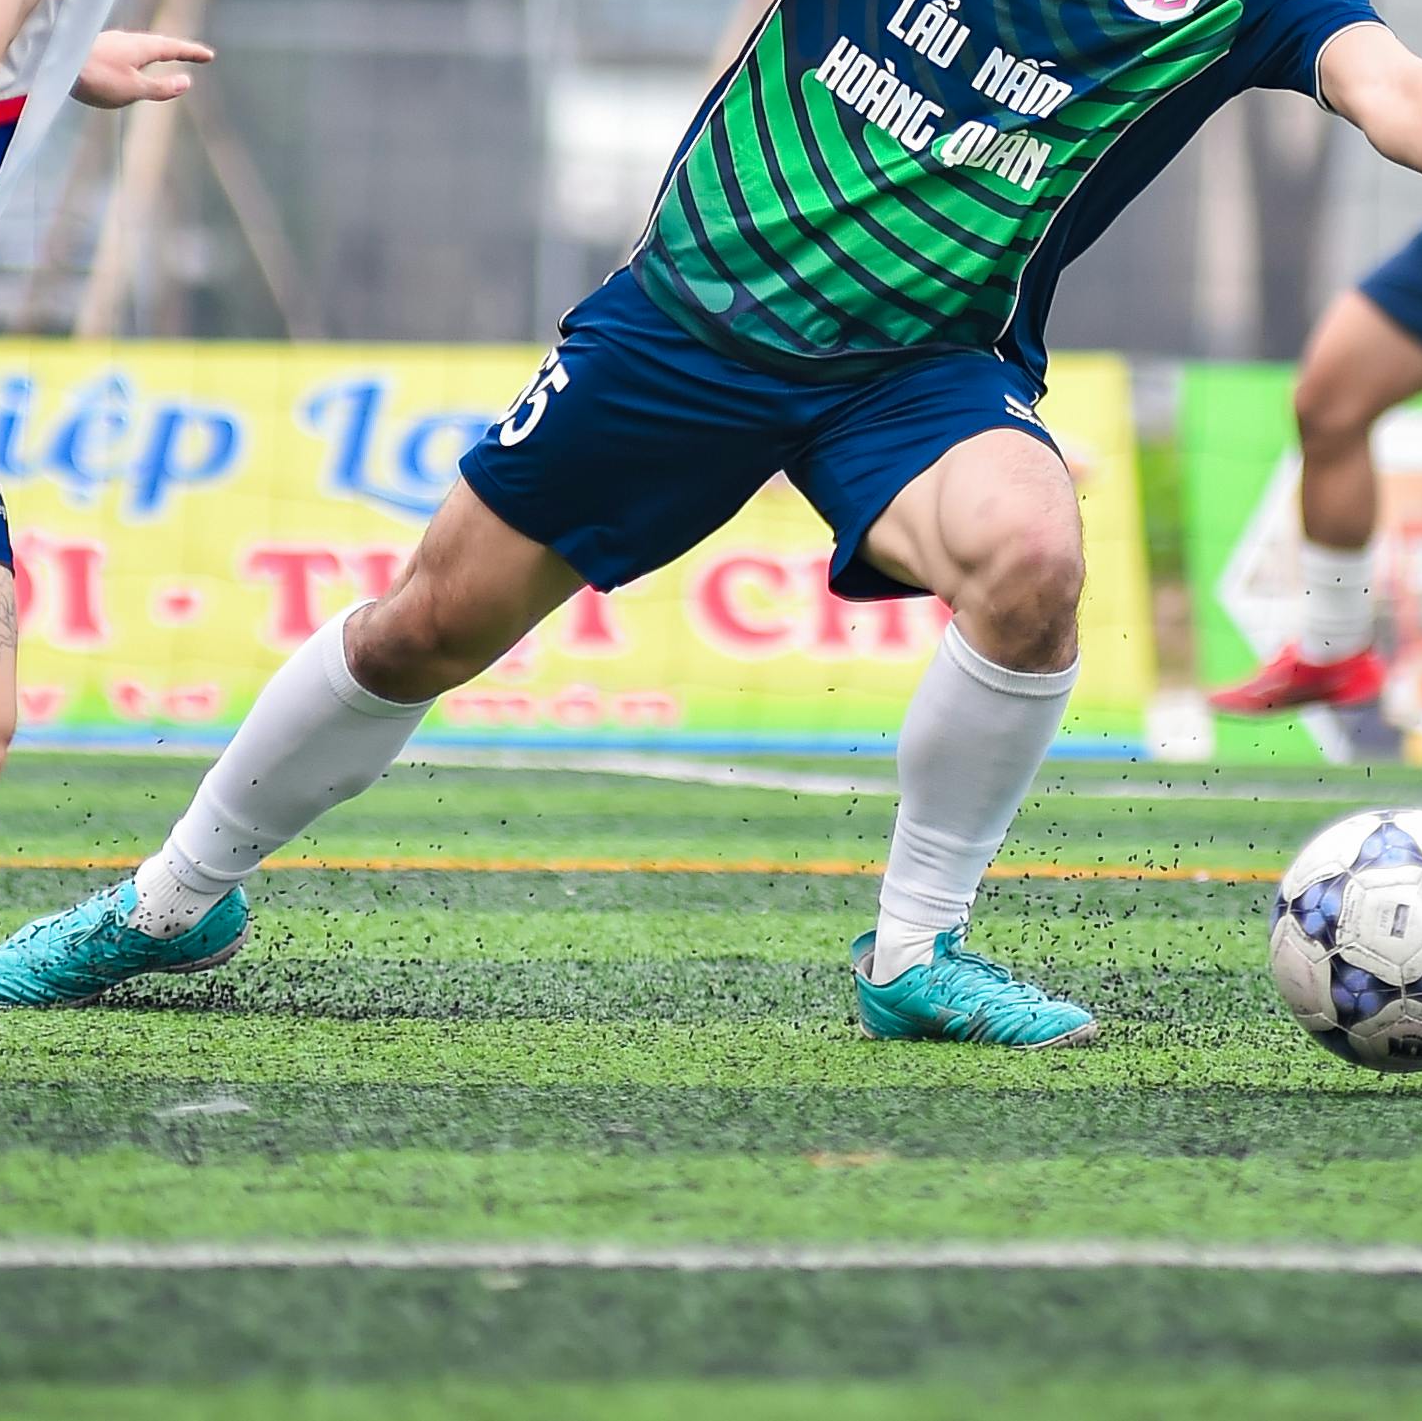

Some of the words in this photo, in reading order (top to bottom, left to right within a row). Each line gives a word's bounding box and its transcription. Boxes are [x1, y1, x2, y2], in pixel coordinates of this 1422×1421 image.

[814, 35, 945, 152] HOÀNG
[940, 119, 1053, 191] QUÂN
[971, 46, 1073, 119] NẤM
[698, 554, 955, 648] CH
